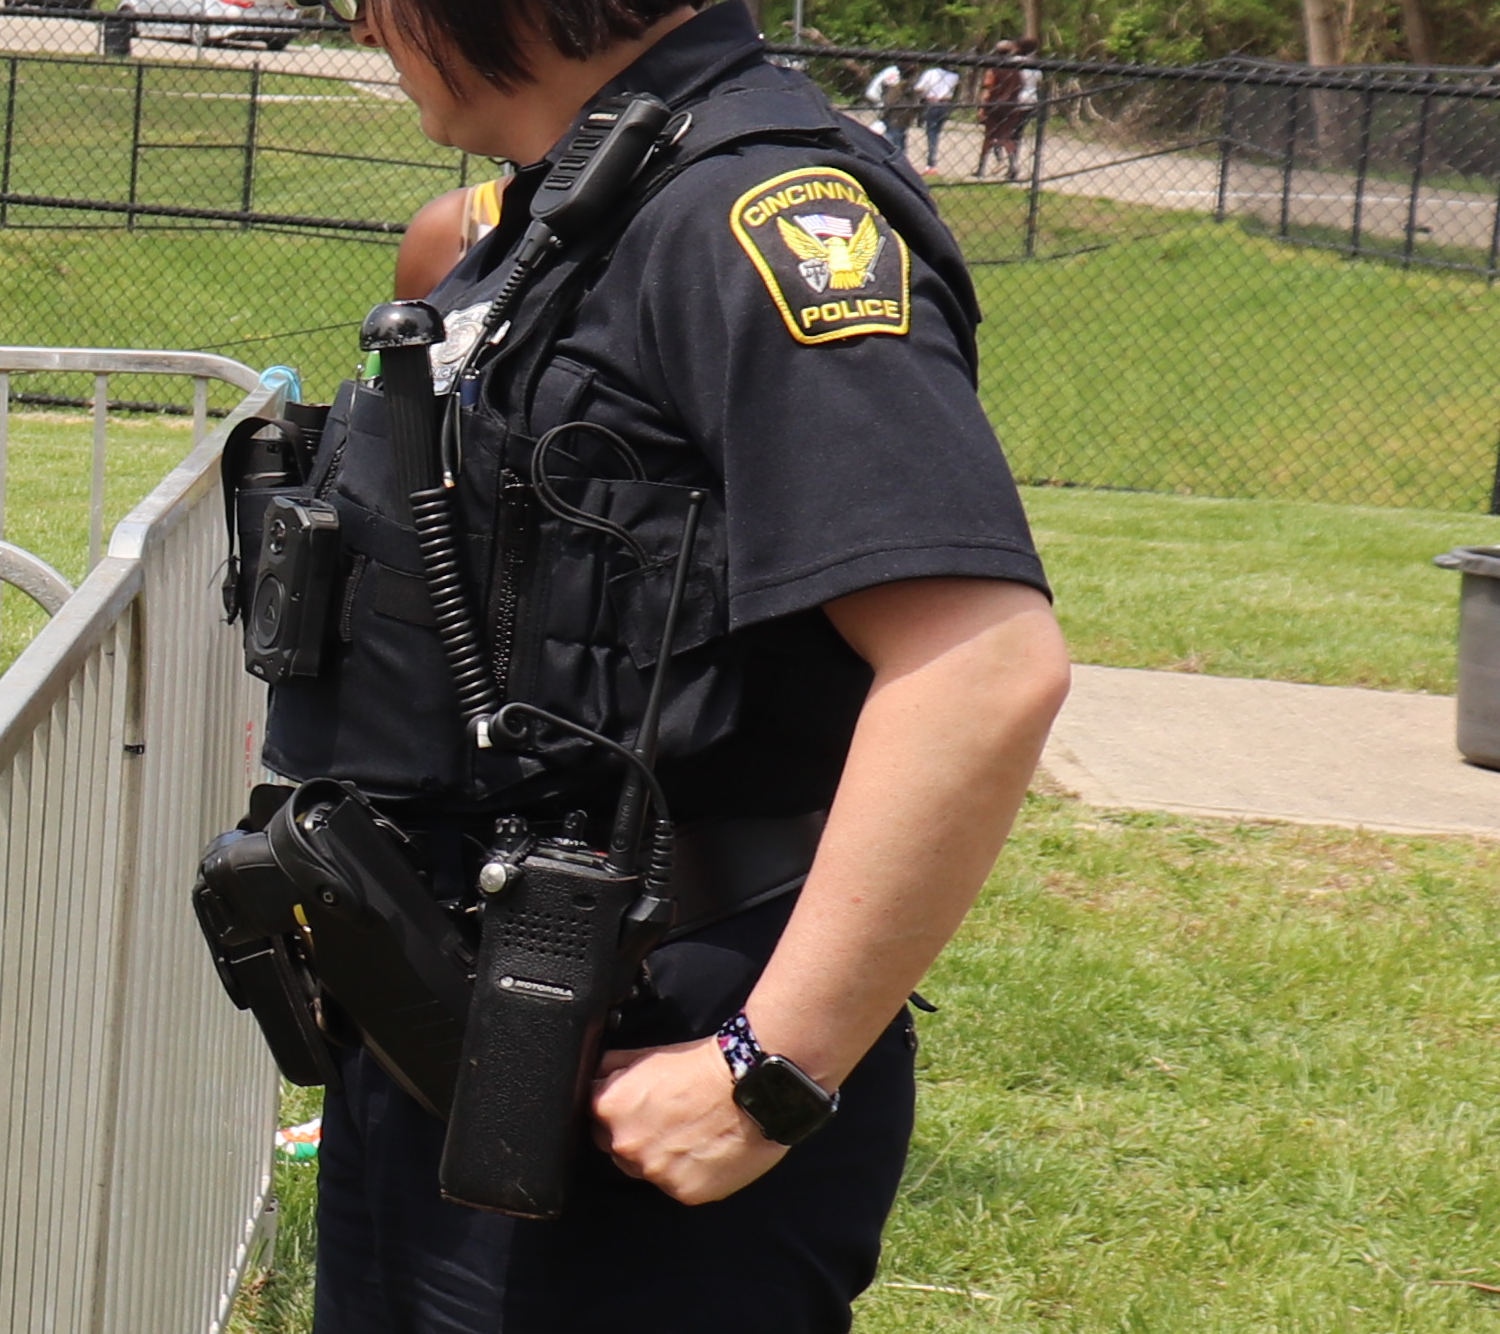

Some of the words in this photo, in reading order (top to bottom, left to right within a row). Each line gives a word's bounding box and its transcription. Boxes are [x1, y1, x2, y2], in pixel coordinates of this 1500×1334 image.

[743, 181, 878, 227] CINCINNA
[801, 299, 900, 328] POLICE
[514, 979, 574, 996] MOTOROLA
